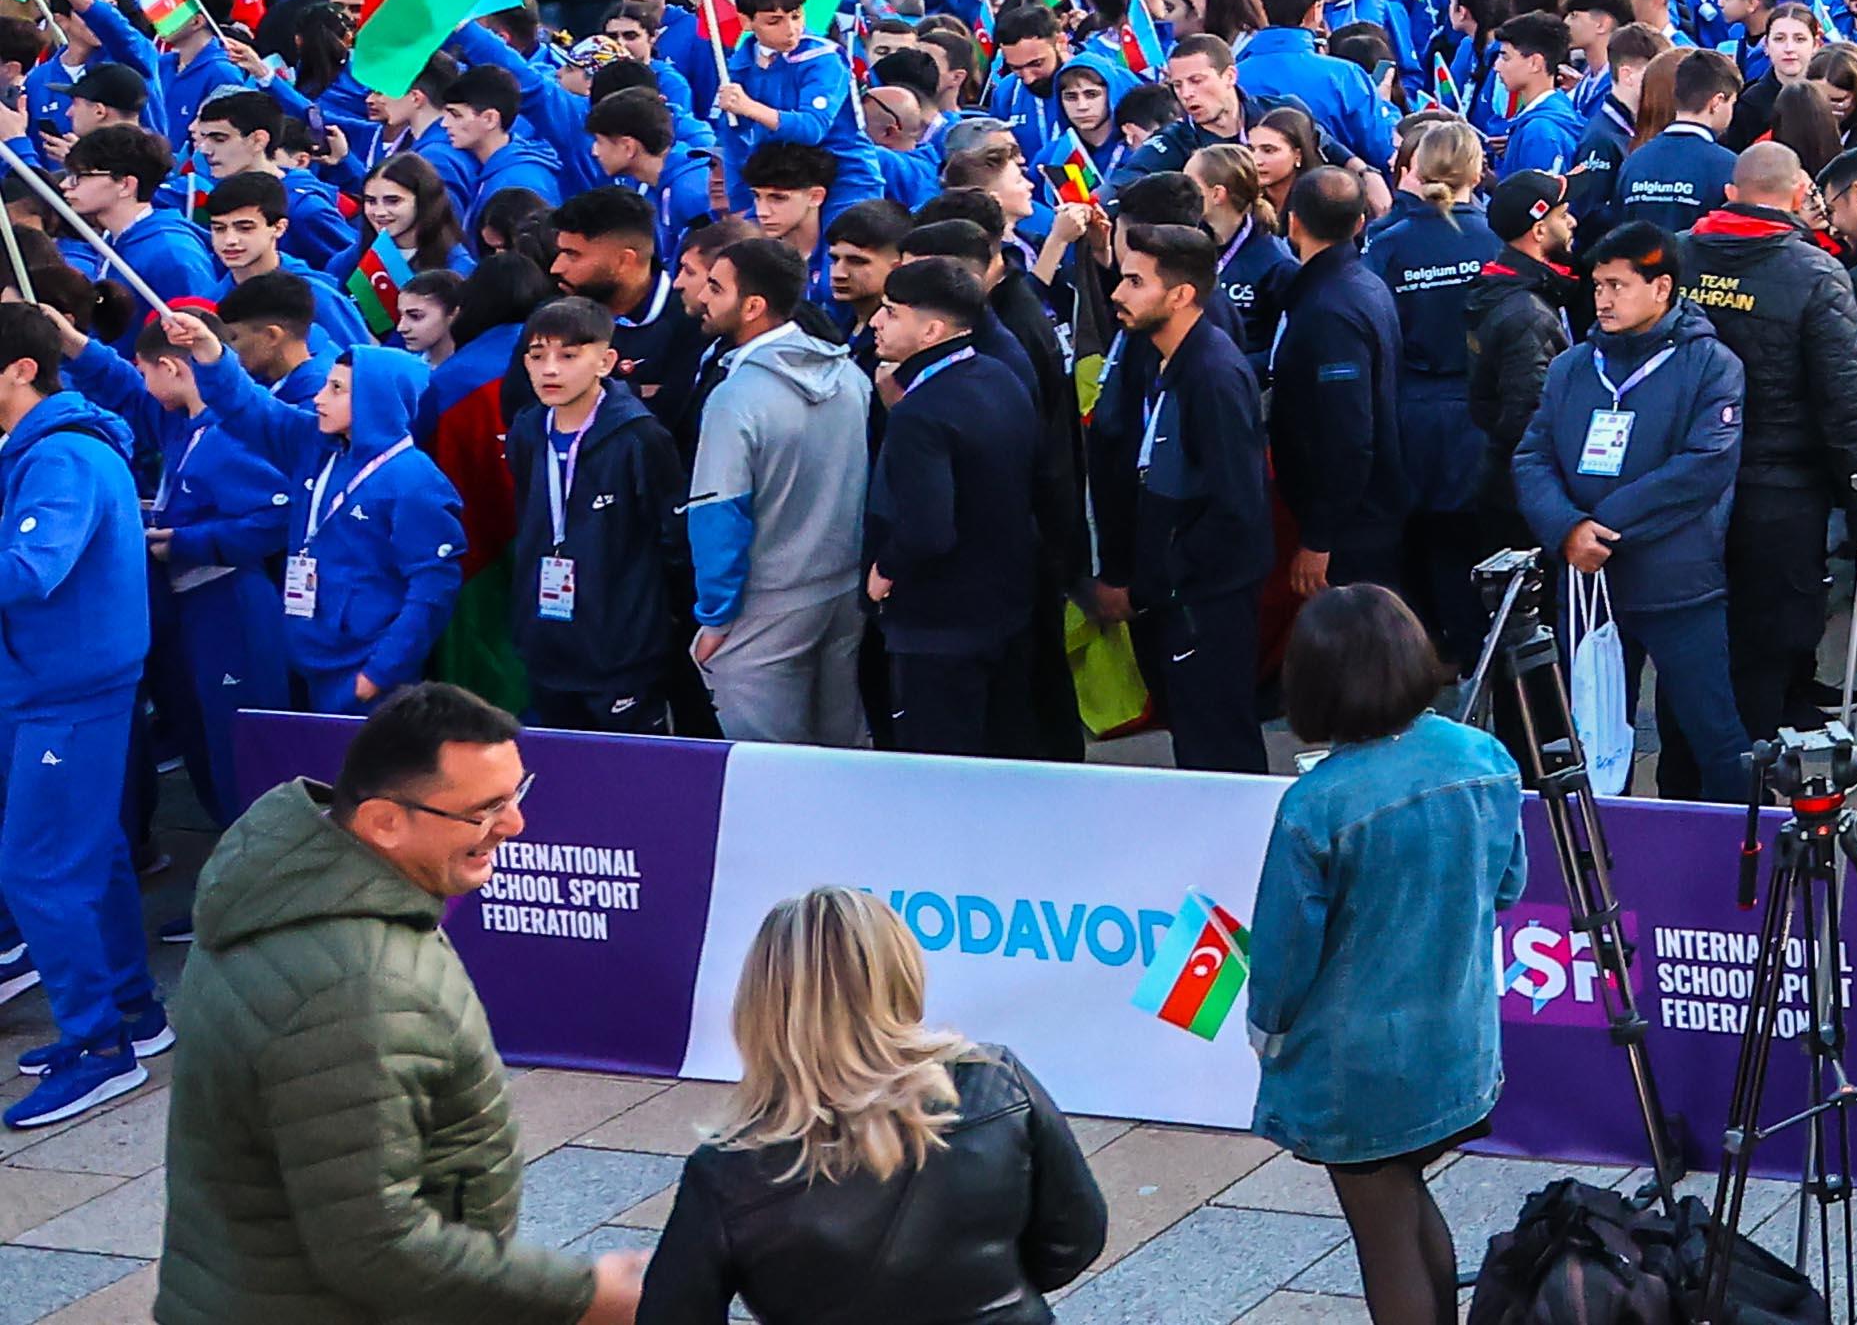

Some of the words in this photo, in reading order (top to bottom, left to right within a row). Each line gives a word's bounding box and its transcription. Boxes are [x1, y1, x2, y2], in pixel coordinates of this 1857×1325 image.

[1632, 180, 1673, 194] Belgium
[1674, 181, 1694, 194] DG
[1403, 265, 1457, 282] Belgium
[1458, 259, 1481, 274] DG
[1700, 274, 1740, 291] TEAM
[568, 878, 640, 910] SPORT
[481, 903, 609, 941] FEDERATION
